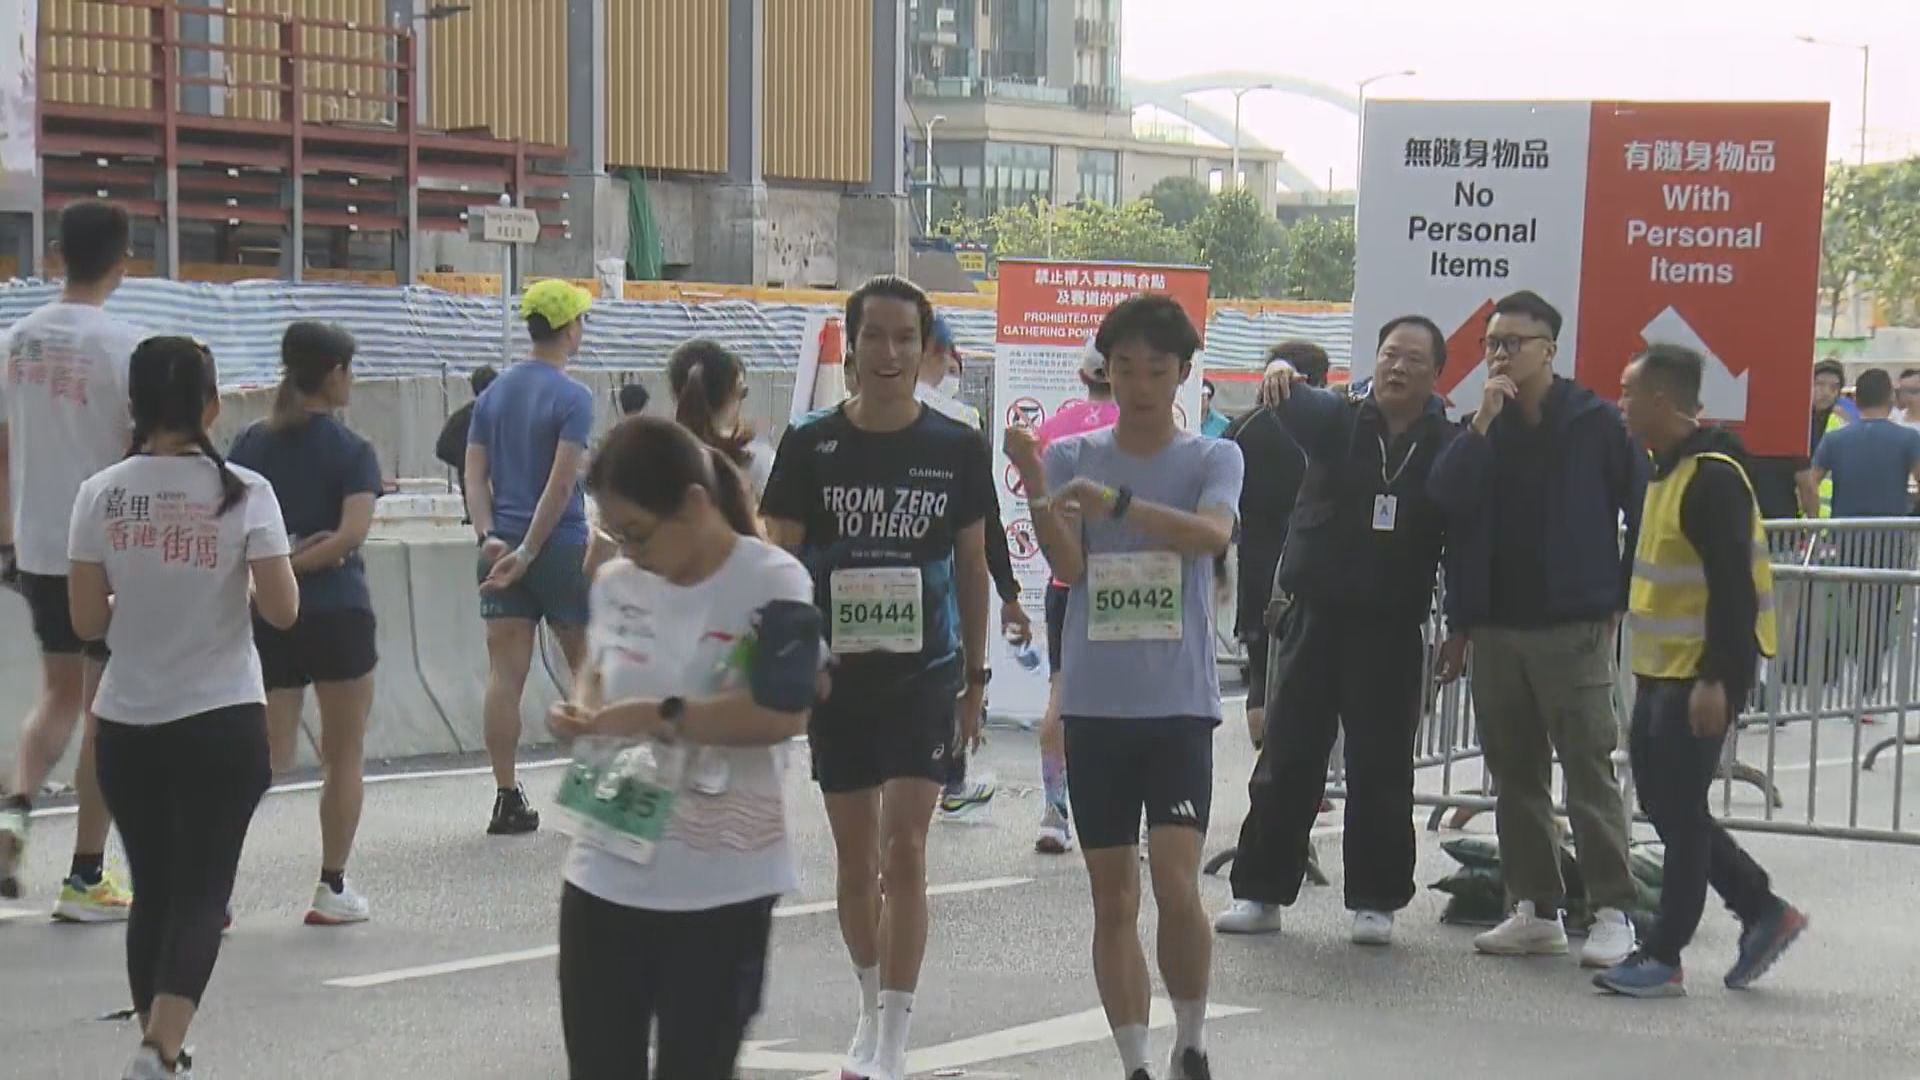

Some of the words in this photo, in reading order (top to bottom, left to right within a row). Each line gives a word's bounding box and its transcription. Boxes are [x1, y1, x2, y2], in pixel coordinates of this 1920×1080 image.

[1404, 138, 1549, 170] 無隨身物品
[1623, 140, 1776, 172] 有隨身物品
[1454, 181, 1494, 207] No
[1662, 184, 1731, 211] With
[1408, 216, 1537, 243] Personal
[1627, 219, 1762, 248] Personal
[1430, 251, 1510, 278] Items
[1650, 256, 1733, 283] Items
[1024, 311, 1088, 324] PROHIBITED
[1003, 325, 1066, 338] GATHERING
[909, 467, 954, 480] GARMIN
[822, 486, 885, 513] FROM
[893, 488, 948, 518] ZERO
[836, 511, 863, 537] TO
[870, 512, 930, 539] HERO
[107, 520, 219, 569] 香港街馬
[839, 602, 916, 624] 50444
[1095, 588, 1174, 611] 50442
